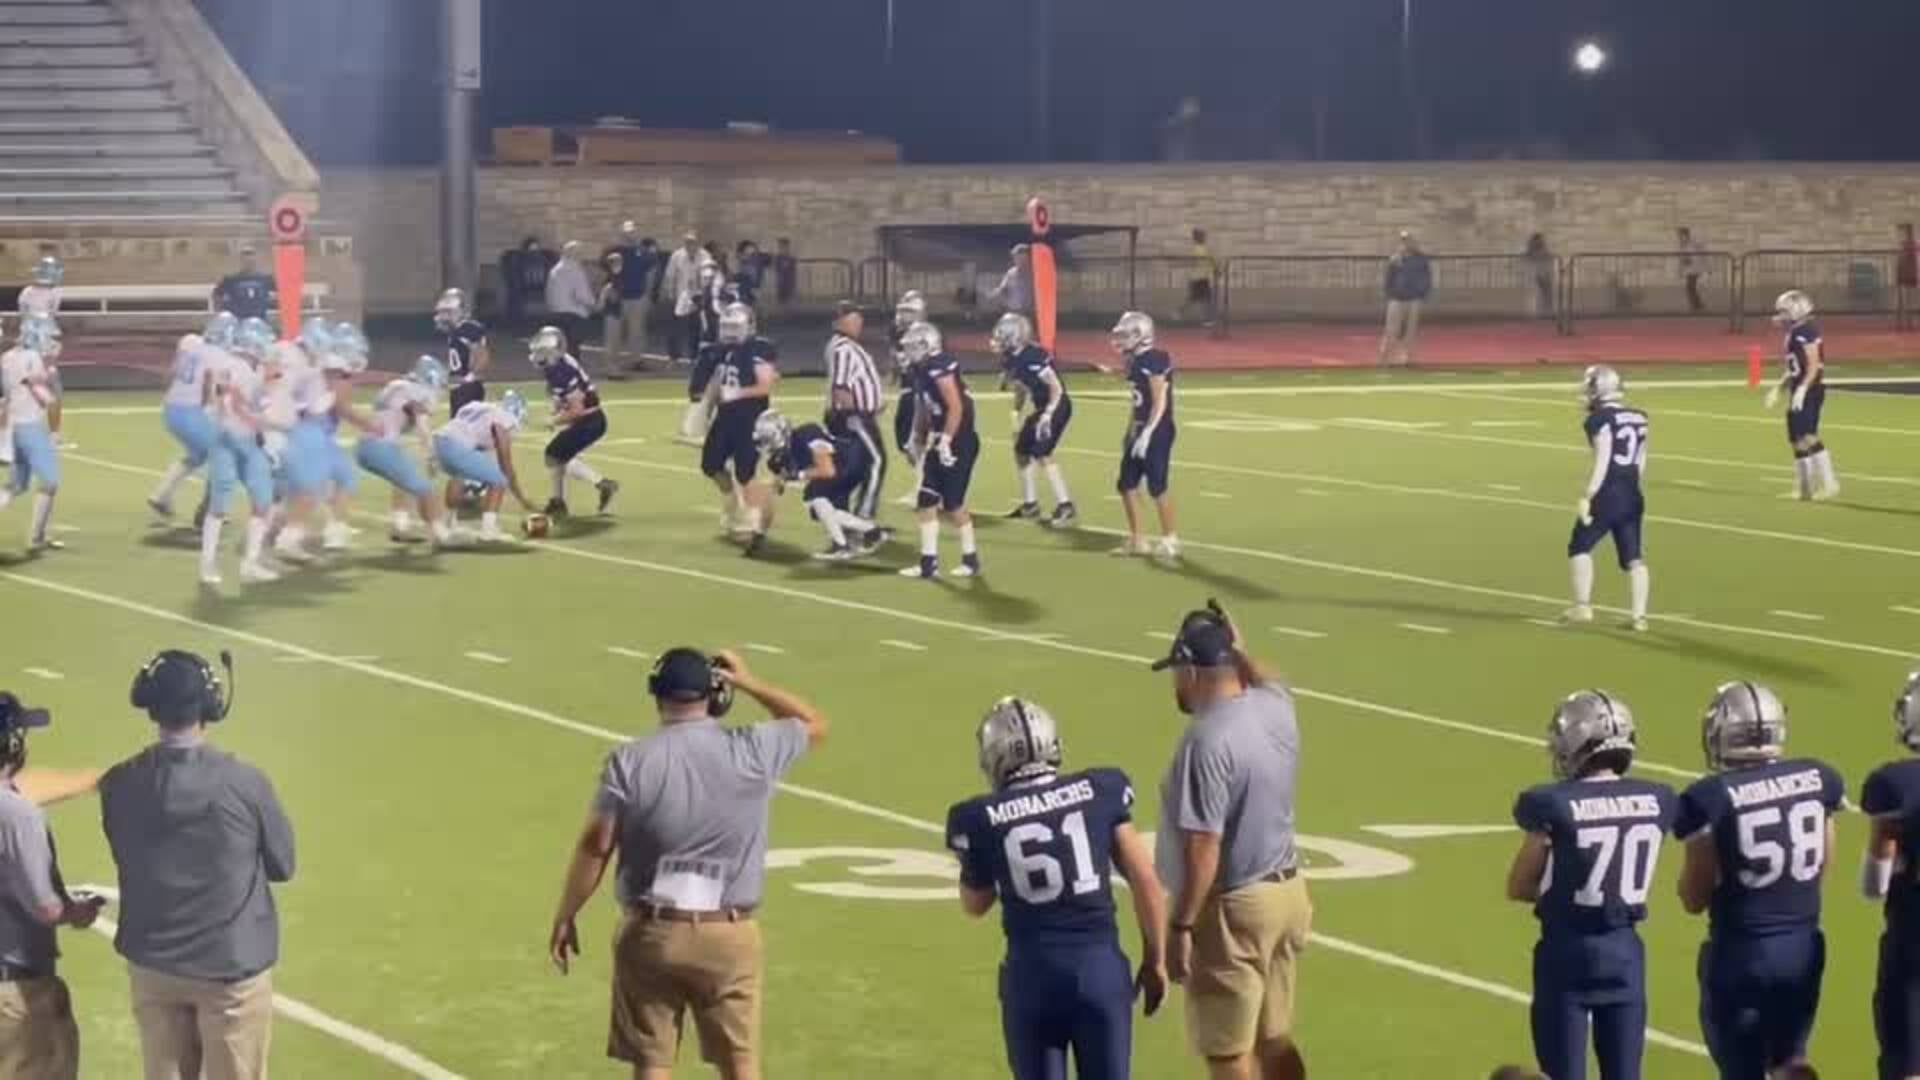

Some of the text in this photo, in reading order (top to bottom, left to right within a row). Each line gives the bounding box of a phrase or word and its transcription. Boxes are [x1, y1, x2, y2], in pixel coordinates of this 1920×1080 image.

[986, 779, 1095, 826] MONARCHS
[1570, 793, 1661, 821] MONARCHS
[1729, 769, 1824, 808] MONARCHS
[1004, 810, 1100, 905] 61
[1573, 823, 1665, 907] 70
[1737, 799, 1827, 889] 58
